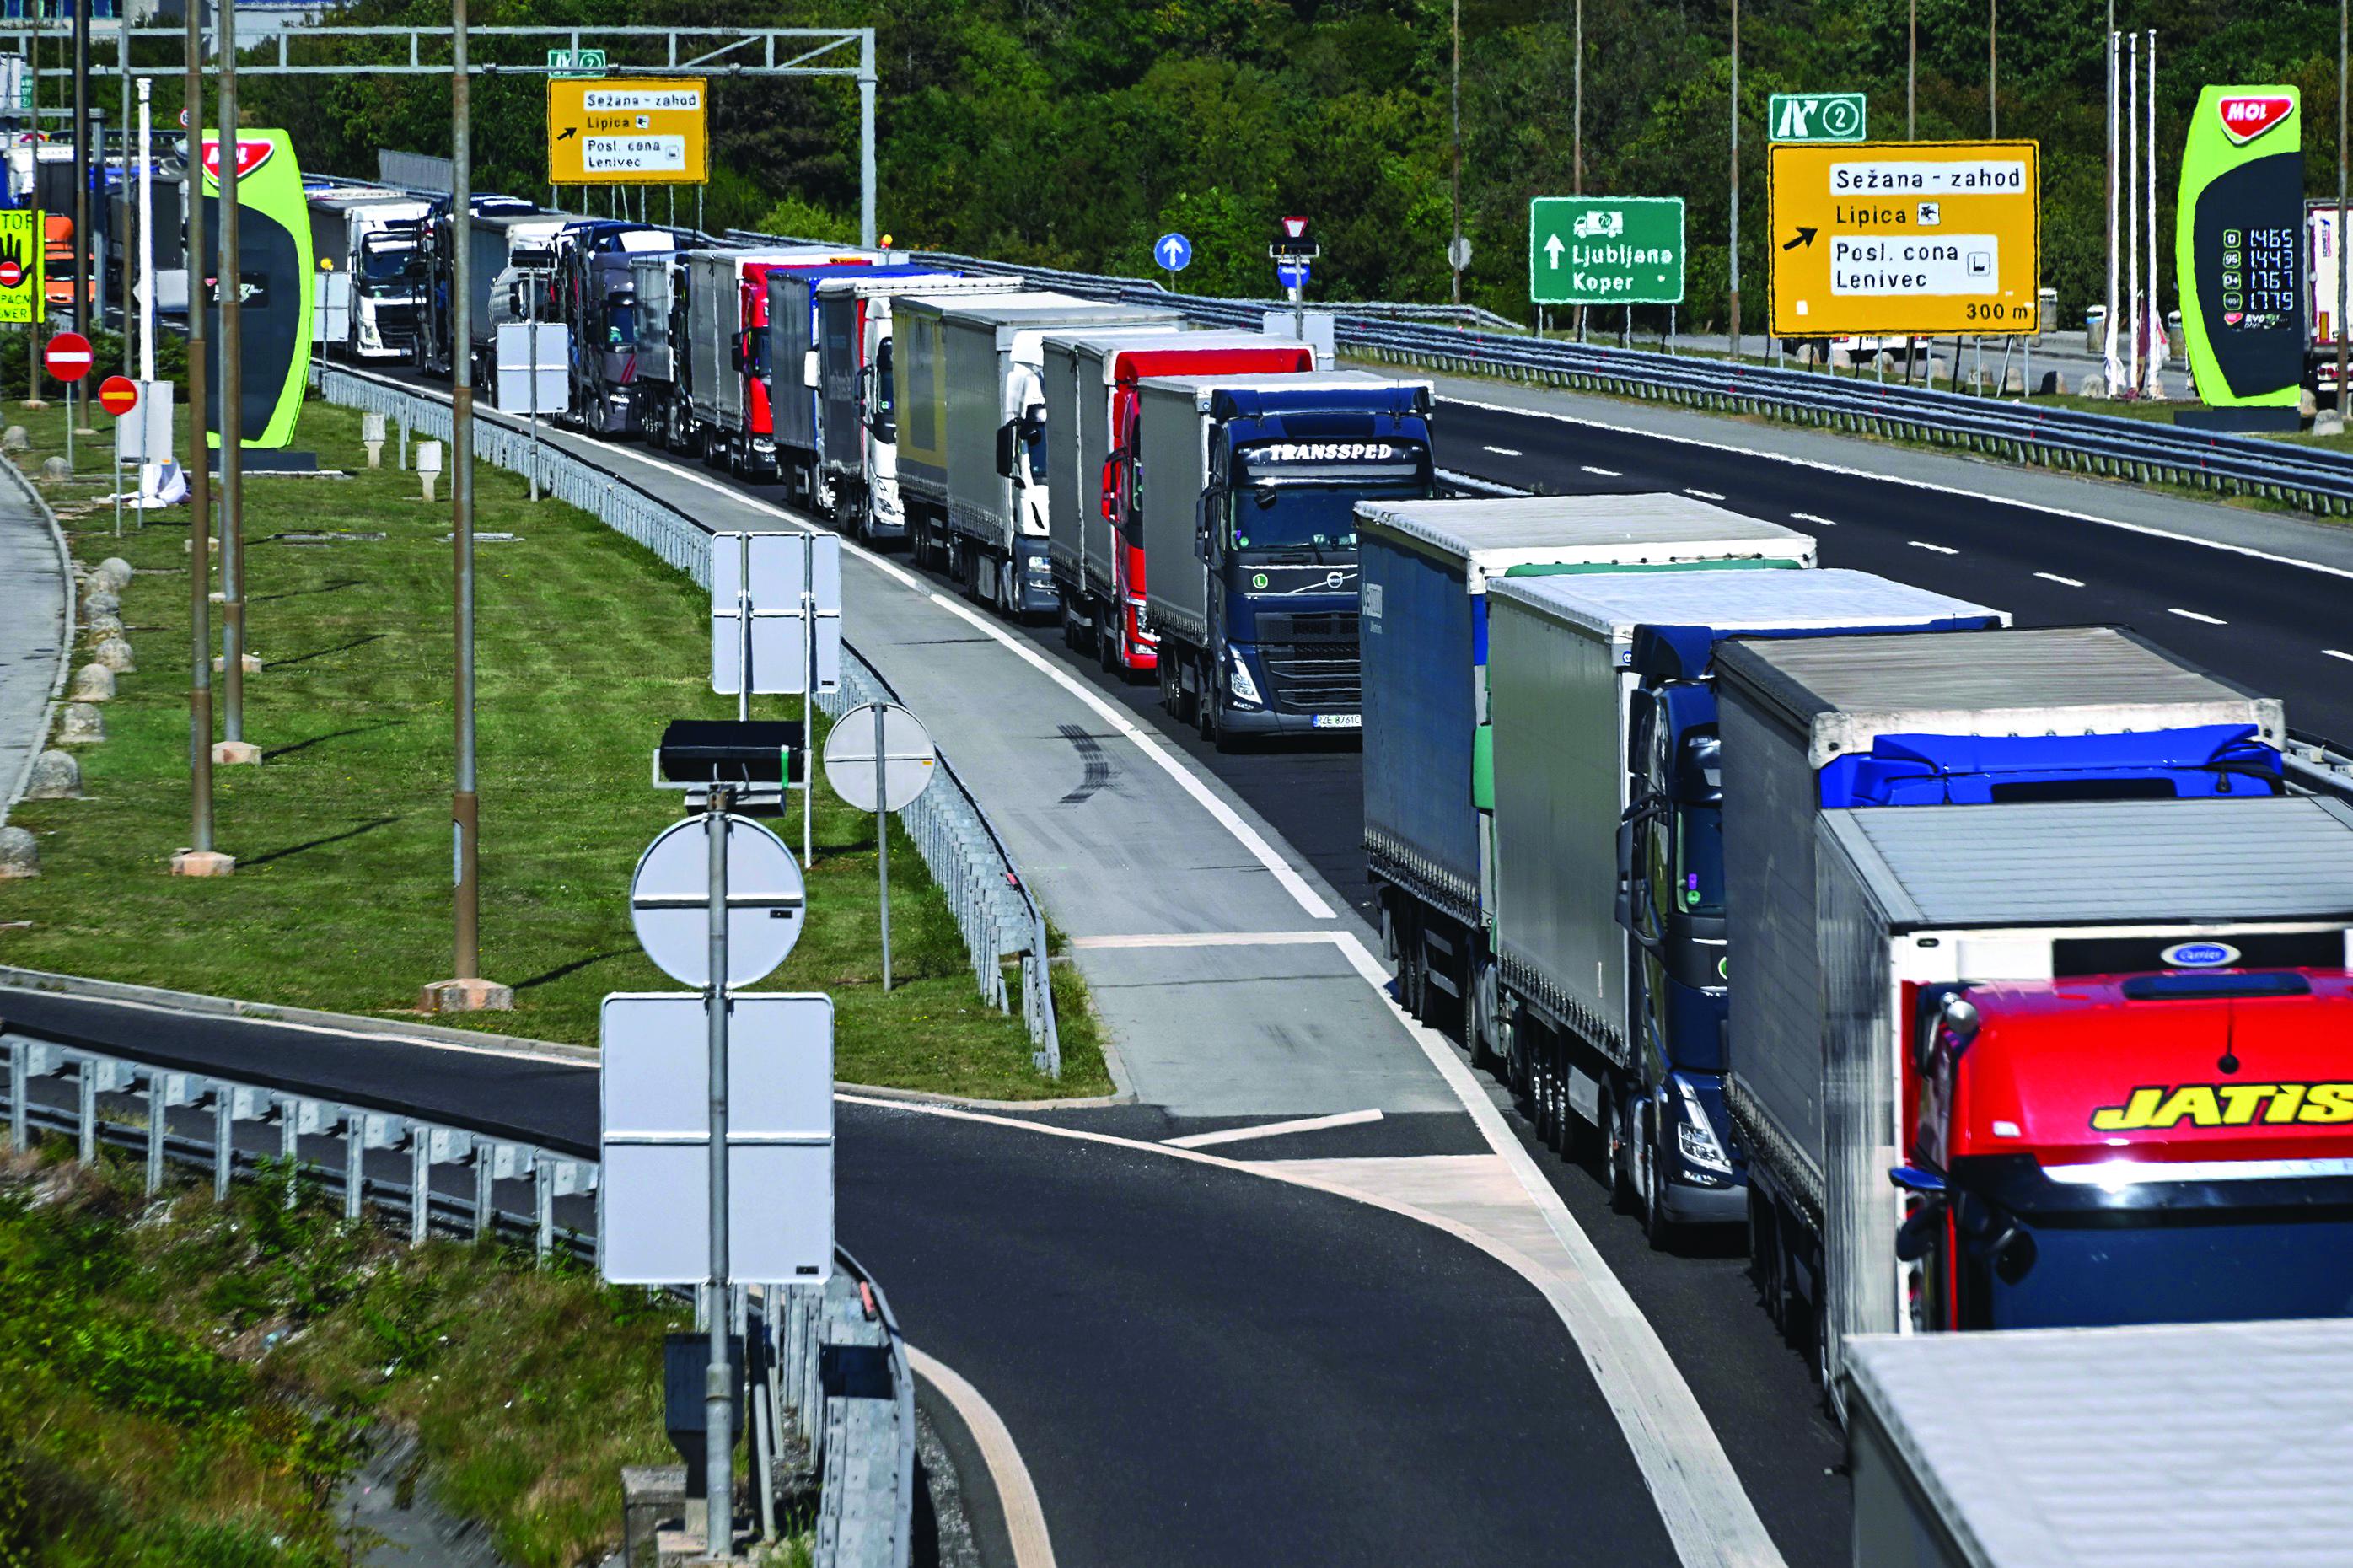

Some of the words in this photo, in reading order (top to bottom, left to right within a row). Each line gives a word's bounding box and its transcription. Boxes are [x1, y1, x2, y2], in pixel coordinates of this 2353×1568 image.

[588, 94, 639, 107] Sežana
[655, 94, 696, 107] zahod
[1835, 107, 1845, 128] 2
[2227, 102, 2268, 121] MOL
[587, 116, 630, 131] Lipica
[588, 140, 621, 152] Posl.
[207, 147, 248, 164] ML
[588, 157, 641, 168] Lenivec
[1836, 169, 1923, 189] Sežana
[1951, 168, 2020, 187] zahod
[1, 213, 33, 229] TOP
[1836, 205, 1906, 228] Lipica
[1572, 244, 1673, 268] Ljubljana
[1836, 243, 1894, 262] Posl.
[1904, 246, 1958, 261] cona
[2225, 254, 2238, 264] 95
[1573, 271, 1634, 294] Koper
[1837, 270, 1927, 288] Lenivec
[1966, 303, 2004, 320] 300
[2012, 307, 2028, 319] m
[1269, 443, 1392, 461] TRANSSPED
[1257, 577, 1264, 586] L
